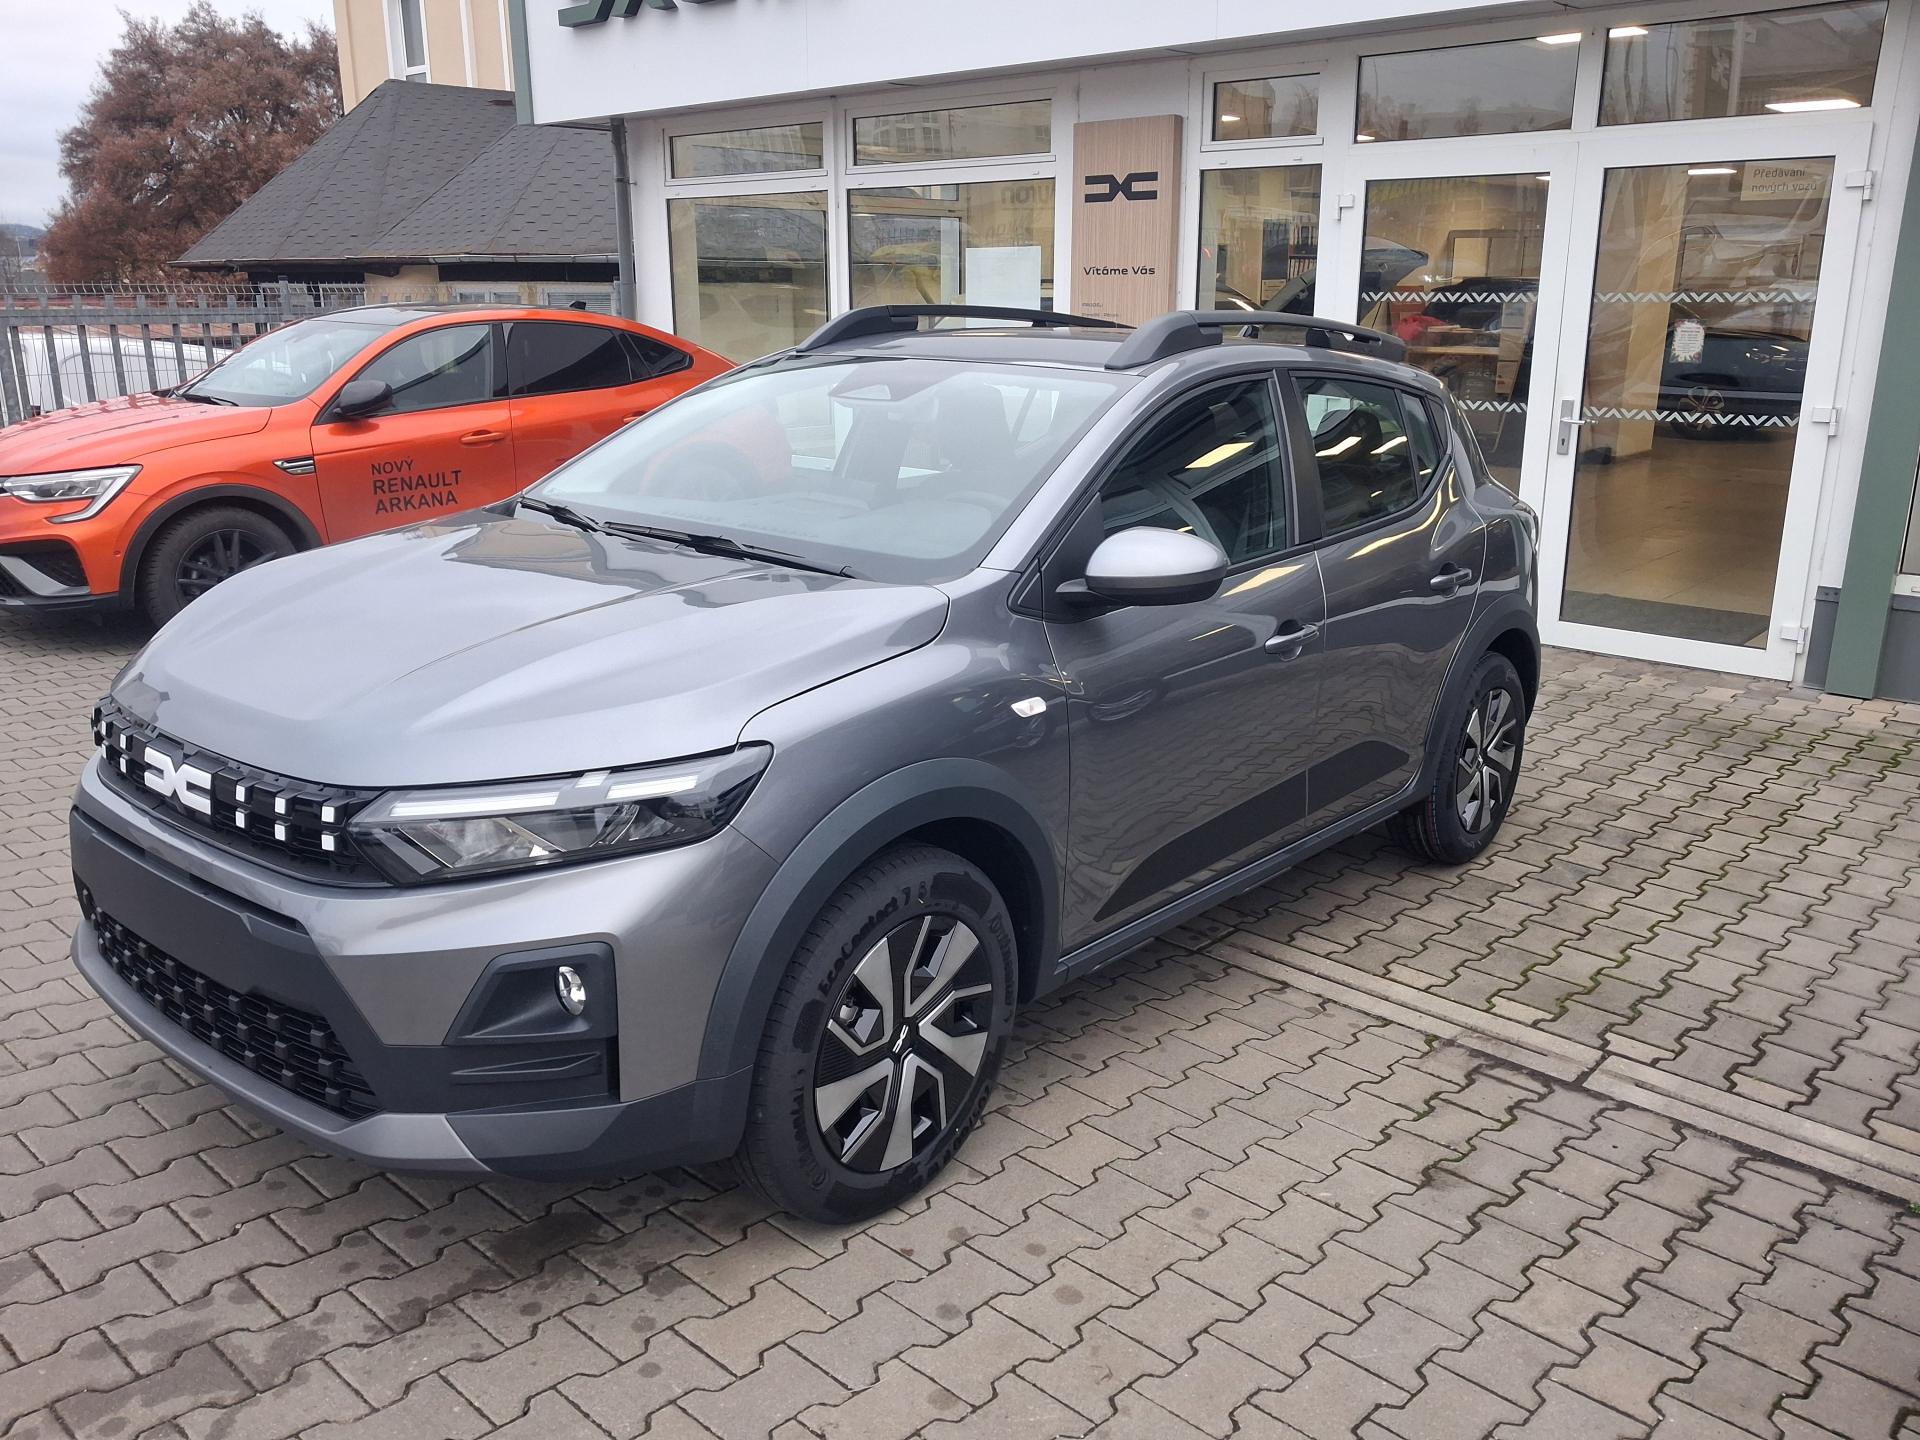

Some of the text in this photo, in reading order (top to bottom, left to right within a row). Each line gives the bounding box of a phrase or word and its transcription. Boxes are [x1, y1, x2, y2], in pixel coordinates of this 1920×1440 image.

[1083, 265, 1156, 276] Vítáme Vás
[371, 456, 414, 476] NOVÝ
[373, 470, 462, 495] RENAULT
[375, 490, 458, 515] ARKANA
